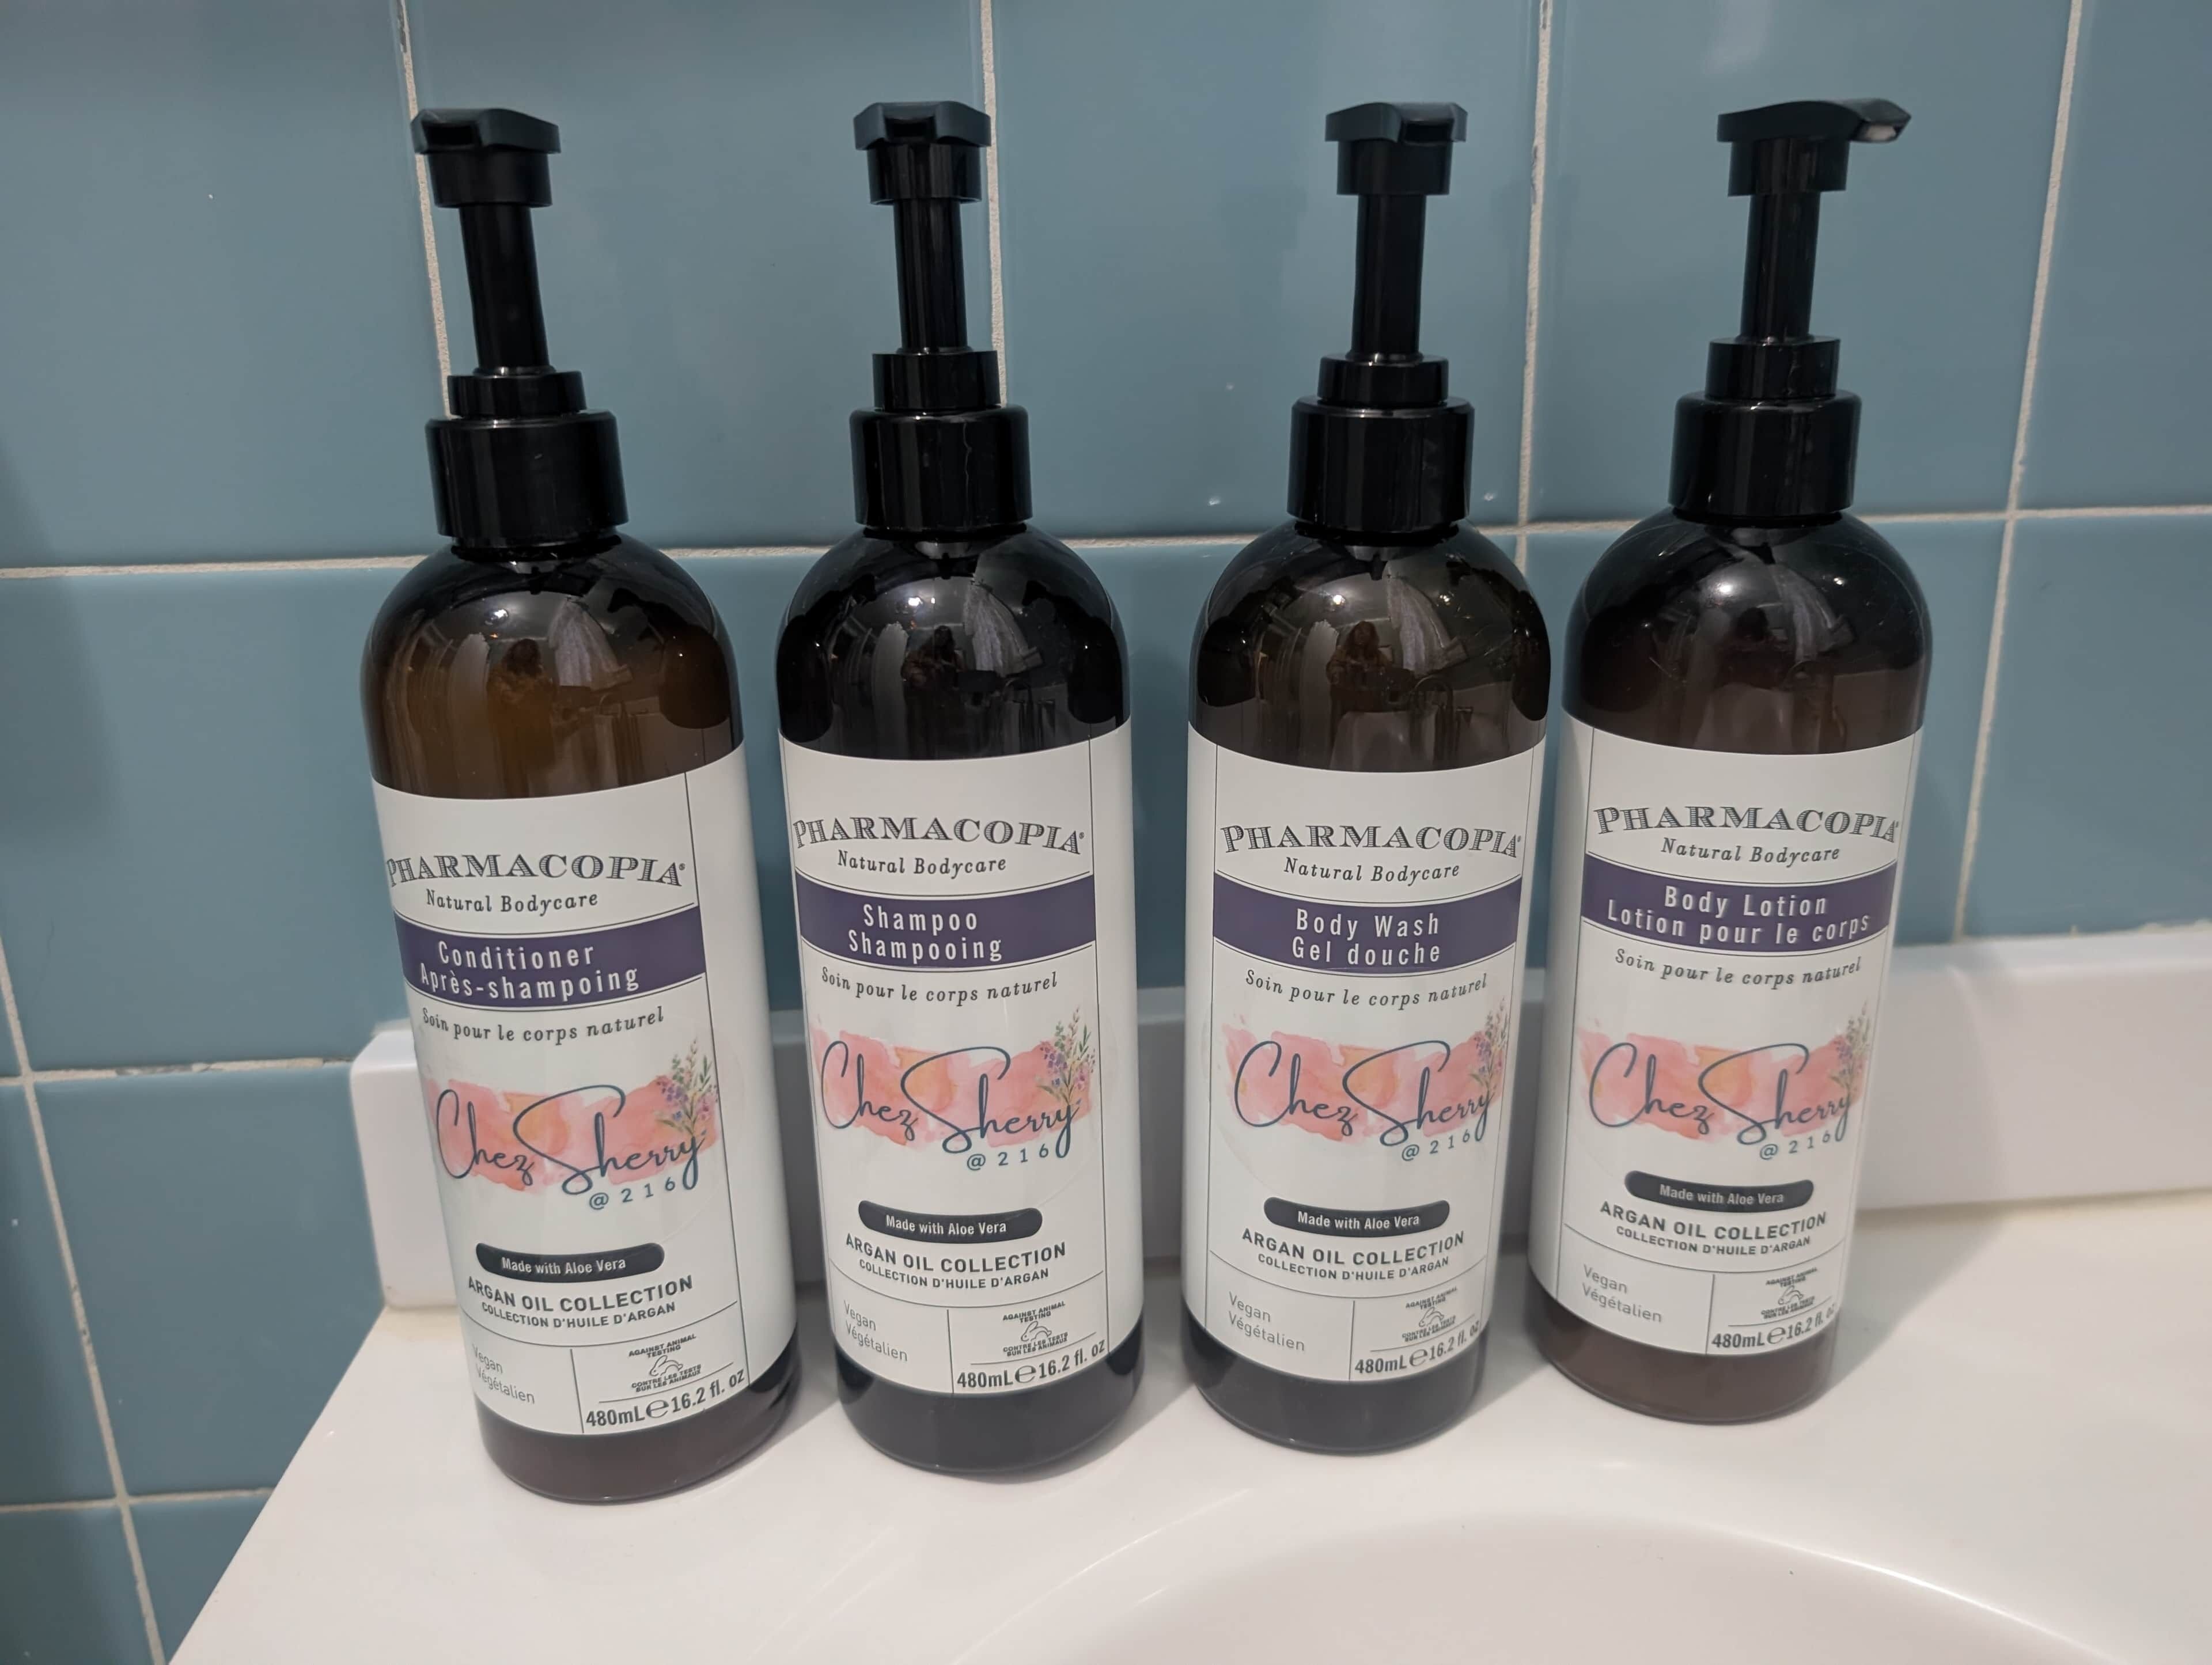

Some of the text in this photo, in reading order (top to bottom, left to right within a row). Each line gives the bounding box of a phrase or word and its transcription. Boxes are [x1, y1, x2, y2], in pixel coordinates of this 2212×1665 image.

[838, 849, 1006, 879] Natural Bodycare
[1661, 837, 1840, 867] Natural Bodycare
[1284, 857, 1460, 886] Natural Bodycare
[426, 889, 598, 916] Natural Bodycare
[1665, 886, 1827, 917] Body Lotion
[863, 904, 978, 935] Shampoo
[1297, 908, 1439, 940] Body Wash
[1608, 900, 1869, 945] Lotion pour le corps
[438, 940, 594, 970] Conditioner
[848, 929, 1002, 964] Shampooing
[1293, 936, 1440, 966] Gel douche
[421, 963, 639, 1002] Après-shampoing
[1615, 948, 1861, 989] Soin pour le corps naturel
[822, 966, 1058, 1007] Soin pour le corps naturel
[1246, 969, 1487, 1010] Soin pour le corps naturel
[423, 1007, 664, 1046] Soin pour le corps naturel
[821, 1041, 1082, 1158] Chez Sherry
[1234, 1040, 1497, 1147] Chez Sherry
[1589, 1042, 1852, 1145] Chez Sherry
[436, 1084, 706, 1195] Chez Sherry
[1660, 1184, 1783, 1205] Made with Aloe Vera
[886, 1215, 1007, 1235] Made with Aloe Vera
[1298, 1211, 1419, 1230] Made with Aloe Vera
[1600, 1201, 1826, 1240] ARGAN OIL COLLECTION
[846, 1233, 1066, 1272] ARGAN OIL COLLECTION
[1242, 1228, 1464, 1265] ARGAN OIL COLLECTION
[1616, 1226, 1810, 1255] COLLECTION D'HUILE D'ARGAN
[502, 1257, 626, 1275] Made with Aloe Vera
[859, 1259, 1049, 1289] COLLECTION D'HUILE D'ARGAN
[1259, 1254, 1449, 1280] COLLECTION D'HUILE D'ARGAN
[1584, 1264, 1627, 1294] Vegan
[468, 1275, 692, 1312] ARGAN OIL COLLECTION
[1229, 1292, 1271, 1322] Vegan
[1406, 1296, 1435, 1309] AGAINST
[1582, 1283, 1661, 1323] Végétalien
[482, 1302, 675, 1328] COLLECTION D'HUILE D'ARGAN
[844, 1300, 876, 1331] Vegan
[1003, 1301, 1066, 1321] AGAINST ANIMAL
[1020, 1311, 1051, 1323] TESTING
[629, 1334, 696, 1357] AGAINST ANIMAL
[846, 1320, 908, 1361] Végétalien
[1003, 1344, 1031, 1352] CONTRE
[1048, 1332, 1068, 1342] TESTS
[1228, 1311, 1305, 1351] Végétalien
[1457, 1330, 1467, 1347] fl.
[1470, 1320, 1479, 1336] oz
[472, 1343, 503, 1374] Vegan
[647, 1345, 681, 1358] TESTING
[1074, 1348, 1088, 1367] fl.
[1092, 1340, 1105, 1357] oz
[475, 1366, 535, 1404] Végétalien
[631, 1364, 701, 1388] CONTRE LES TESTS
[636, 1385, 652, 1393] SUR
[669, 1370, 701, 1385] ANIMAUX
[710, 1379, 725, 1398] fl.
[729, 1369, 744, 1387] oz
